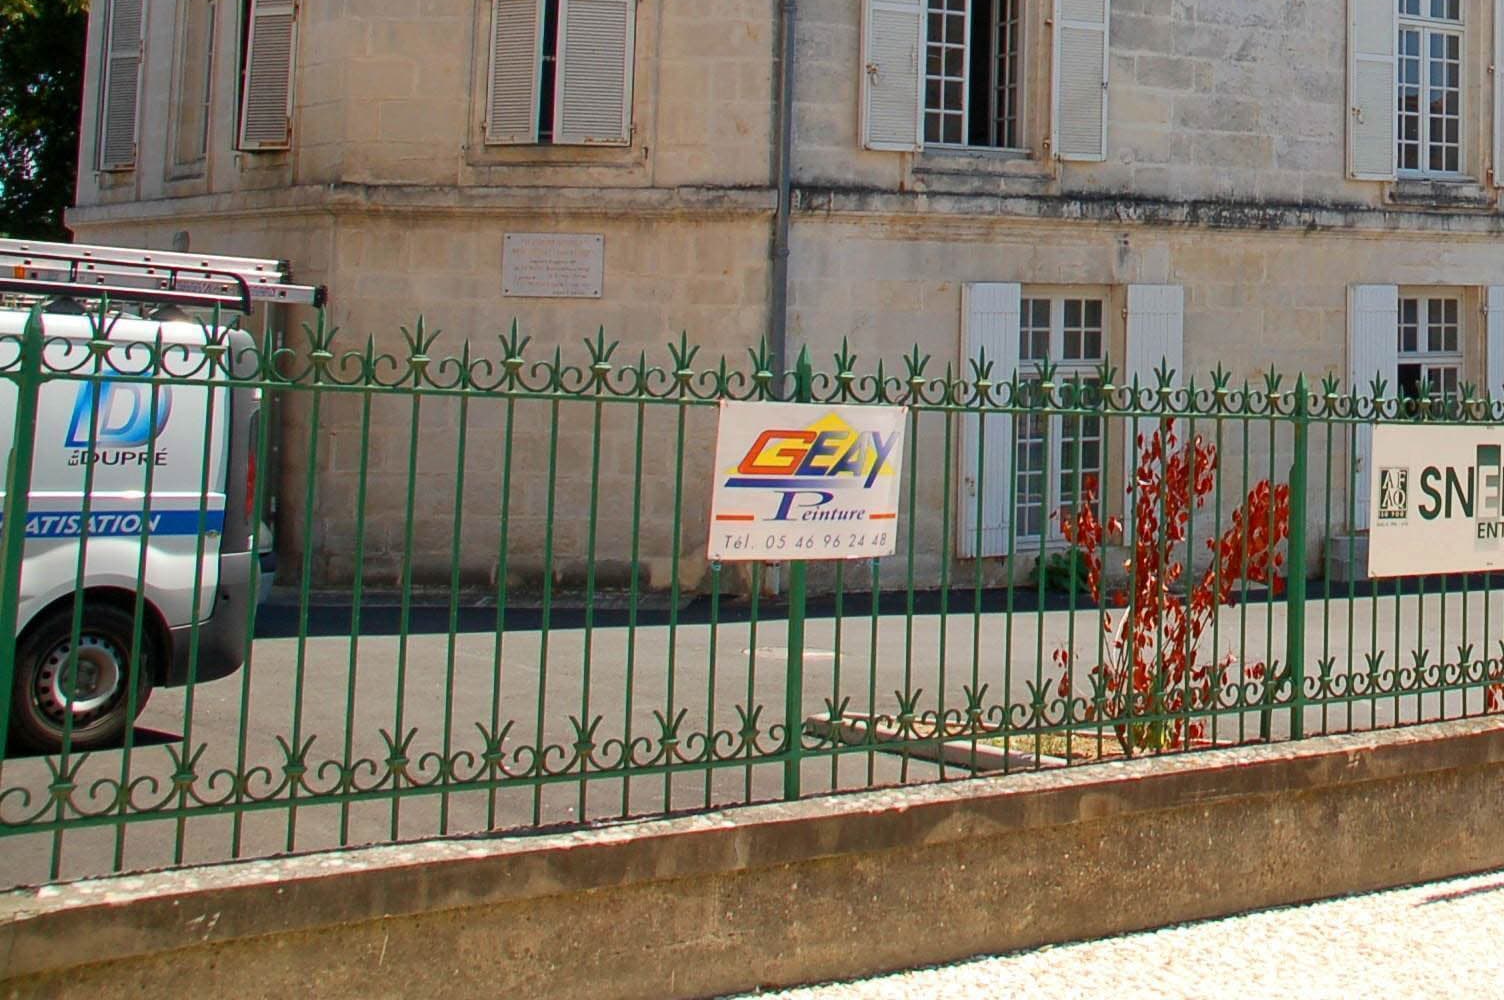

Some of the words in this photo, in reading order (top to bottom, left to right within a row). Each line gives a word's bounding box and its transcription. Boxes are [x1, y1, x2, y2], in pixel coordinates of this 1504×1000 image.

[80, 448, 168, 466] DUPRÉ
[737, 430, 899, 488] GEAY
[763, 490, 866, 521] Peinture
[24, 514, 161, 534] ATISATION
[724, 534, 754, 550] Tél.
[765, 535, 786, 550] 05
[795, 535, 814, 549] 46
[824, 535, 841, 548] 96
[849, 533, 865, 548] 24
[872, 532, 888, 547] 48
